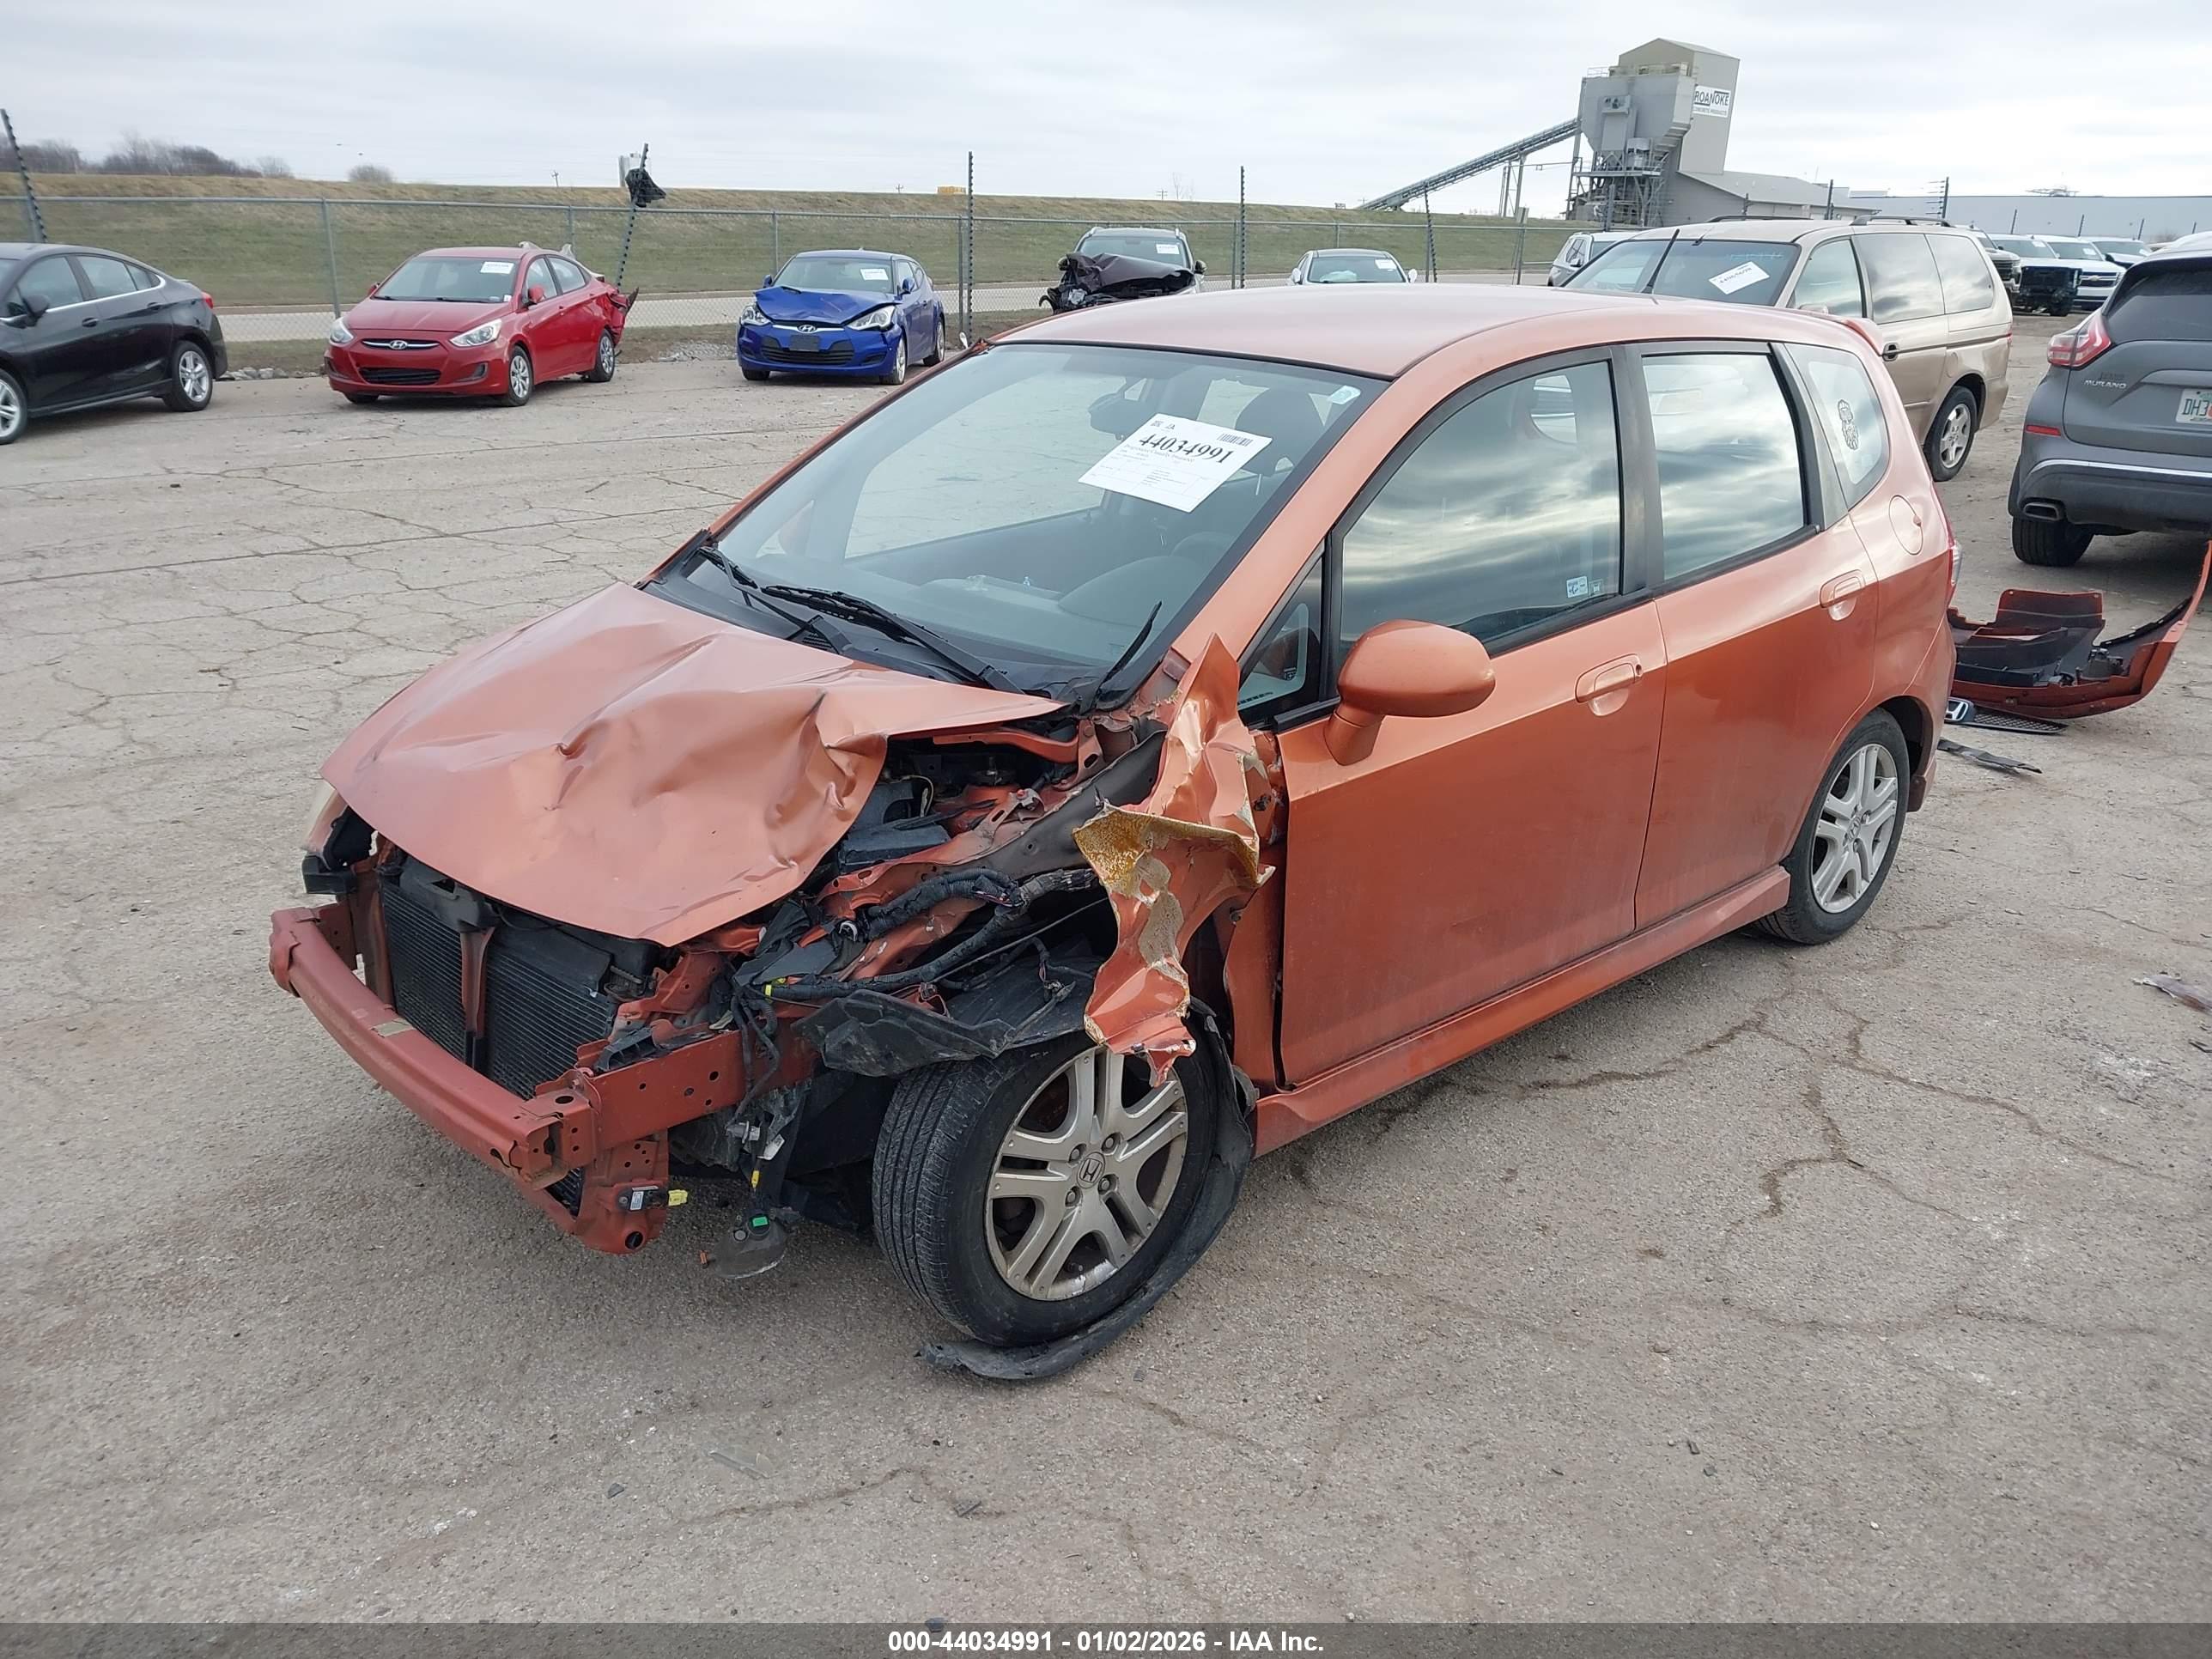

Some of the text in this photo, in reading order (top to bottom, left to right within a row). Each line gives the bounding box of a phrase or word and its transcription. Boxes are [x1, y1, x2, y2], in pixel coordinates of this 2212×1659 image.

[1694, 90, 1729, 106] ROANOKE
[2083, 380, 2127, 389] MURANO
[1139, 433, 1235, 464] 44034991
